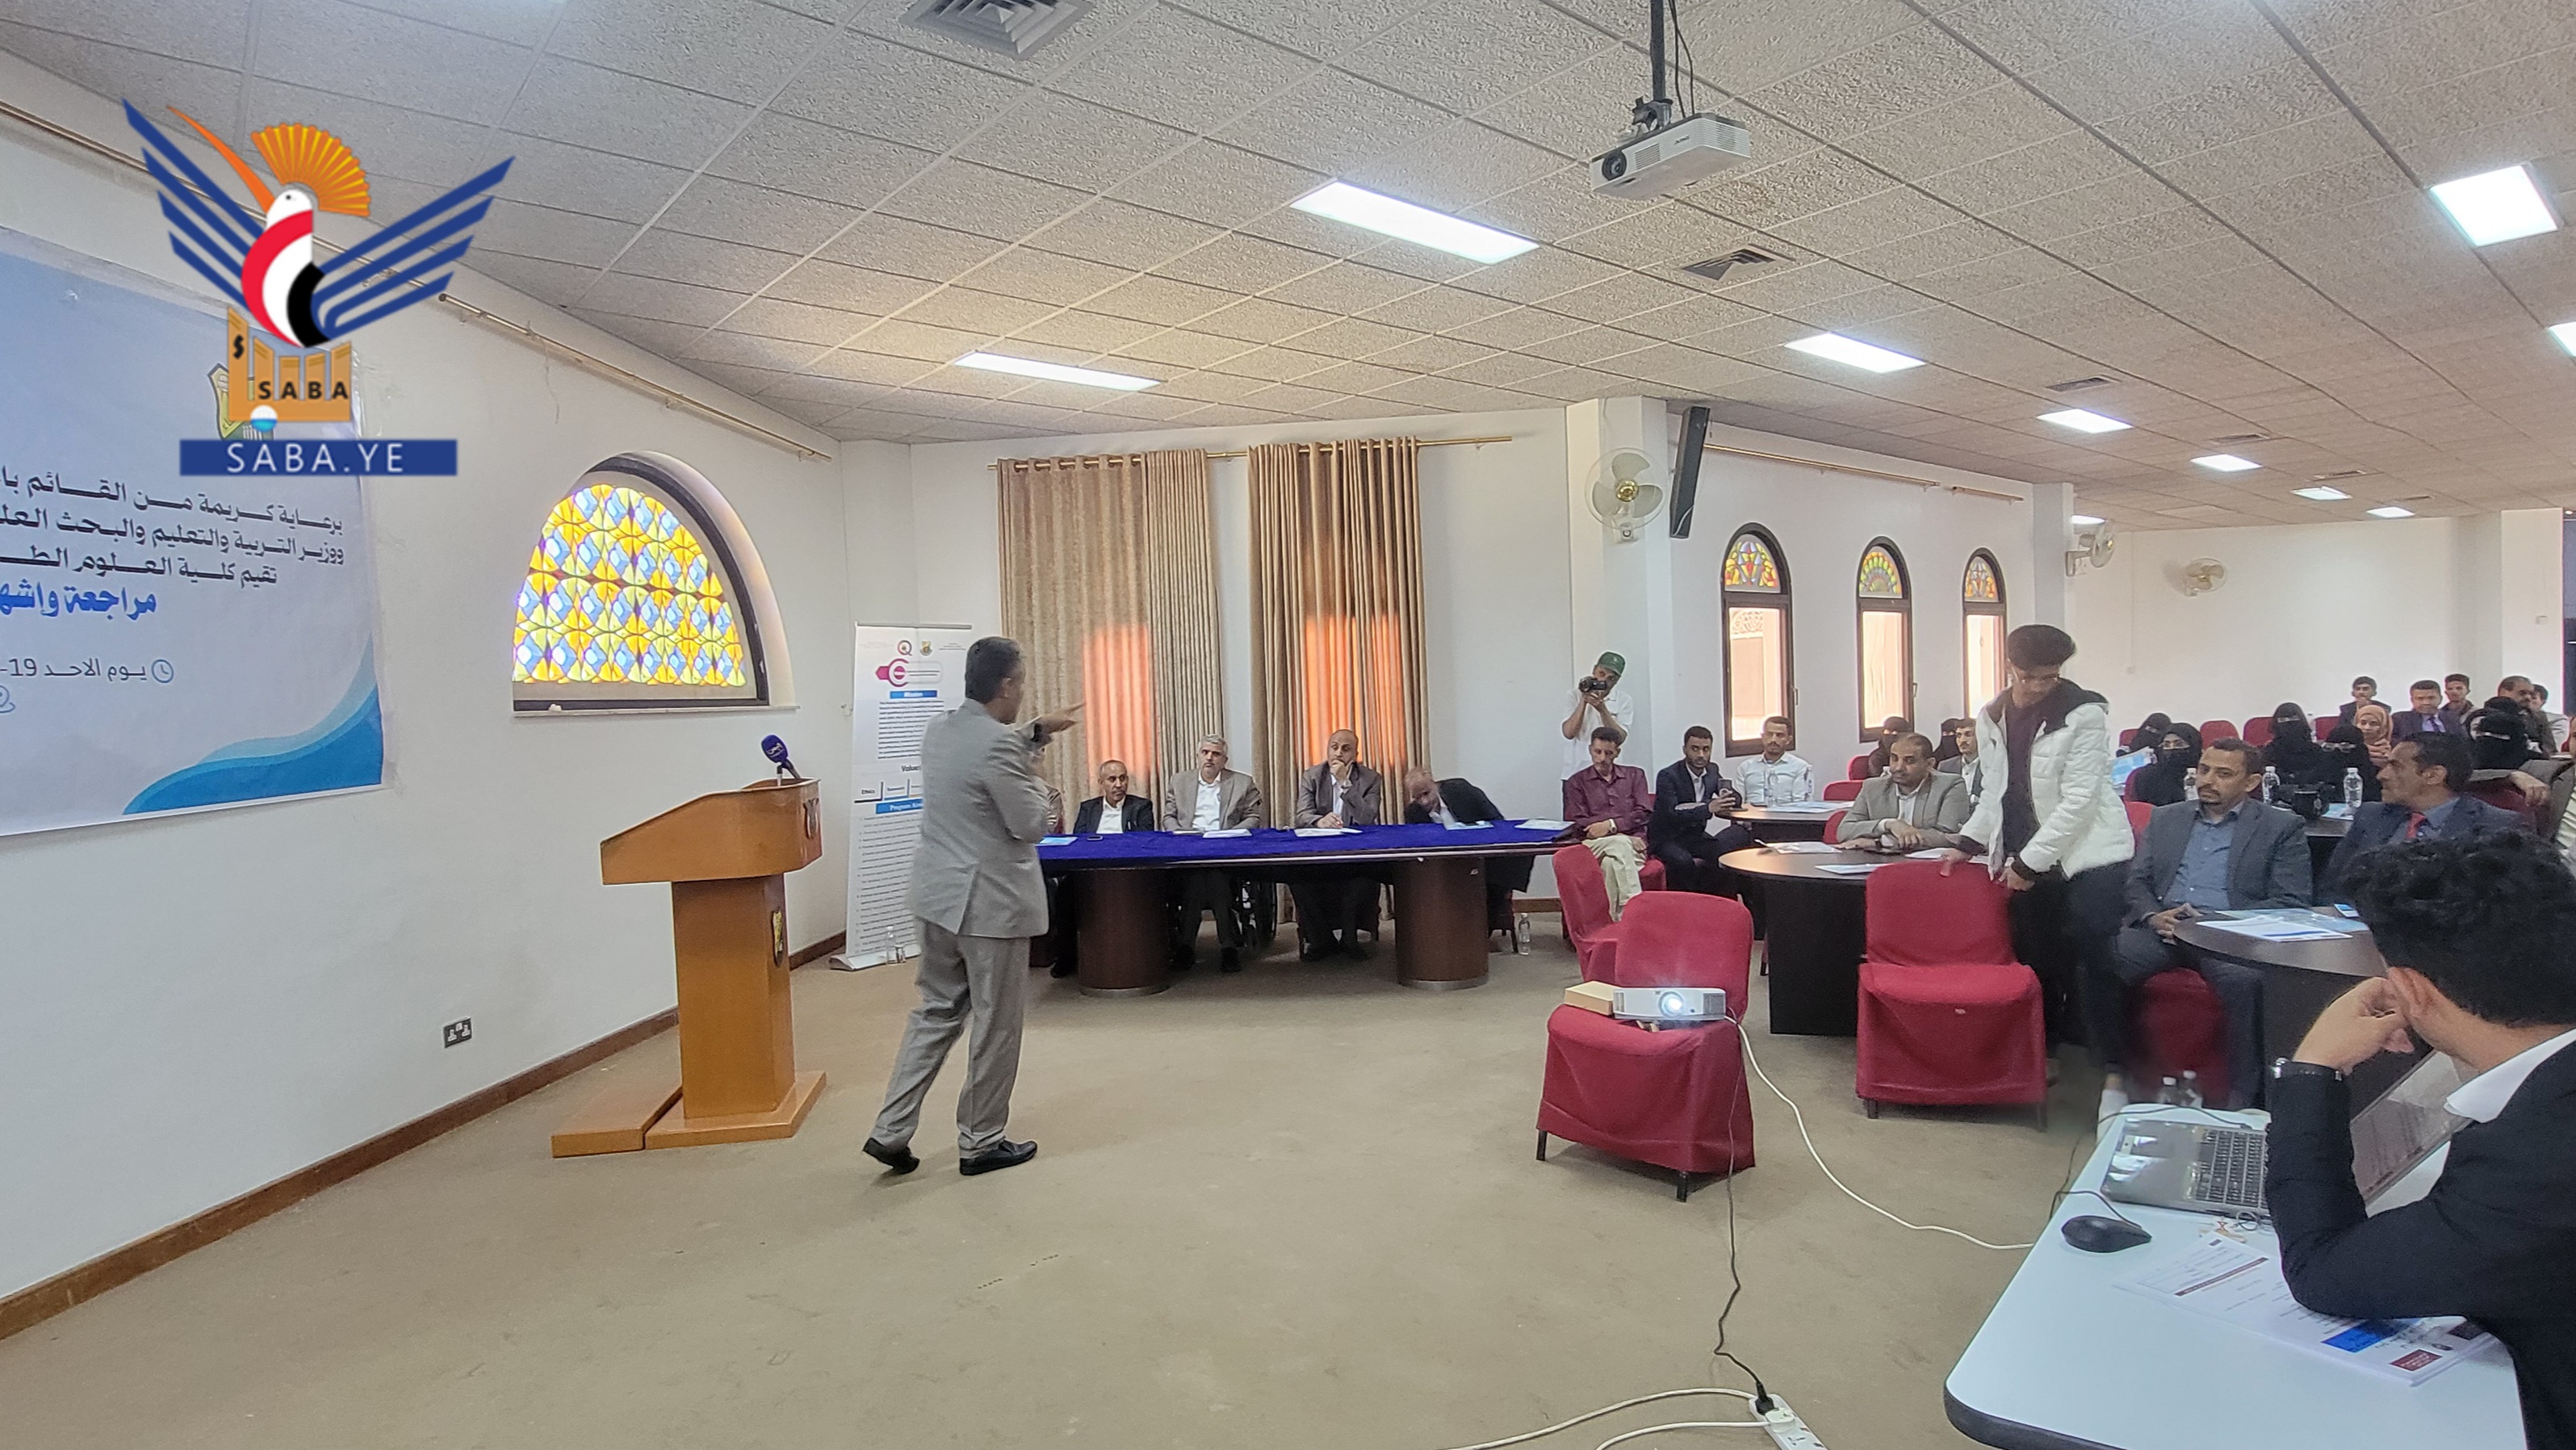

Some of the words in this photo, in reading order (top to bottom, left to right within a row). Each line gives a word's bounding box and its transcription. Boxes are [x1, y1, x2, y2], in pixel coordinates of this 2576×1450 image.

[0, 465, 19, 494] با
[27, 471, 126, 502] القائم
[133, 491, 193, 511] من
[198, 493, 274, 522] كريمة
[0, 504, 48, 530] العل
[56, 512, 146, 545] والبحث
[278, 505, 343, 535] برعاية
[152, 524, 229, 553] والتعليم
[233, 530, 296, 556] التربية
[0, 545, 69, 568] الط
[72, 551, 173, 577] العلوم
[298, 542, 344, 564] ووزير
[178, 558, 236, 583] كلية
[241, 565, 278, 589] تقيم
[64, 586, 157, 621] مراجعة
[44, 658, 101, 677] الاحد
[107, 666, 148, 682] يوم
